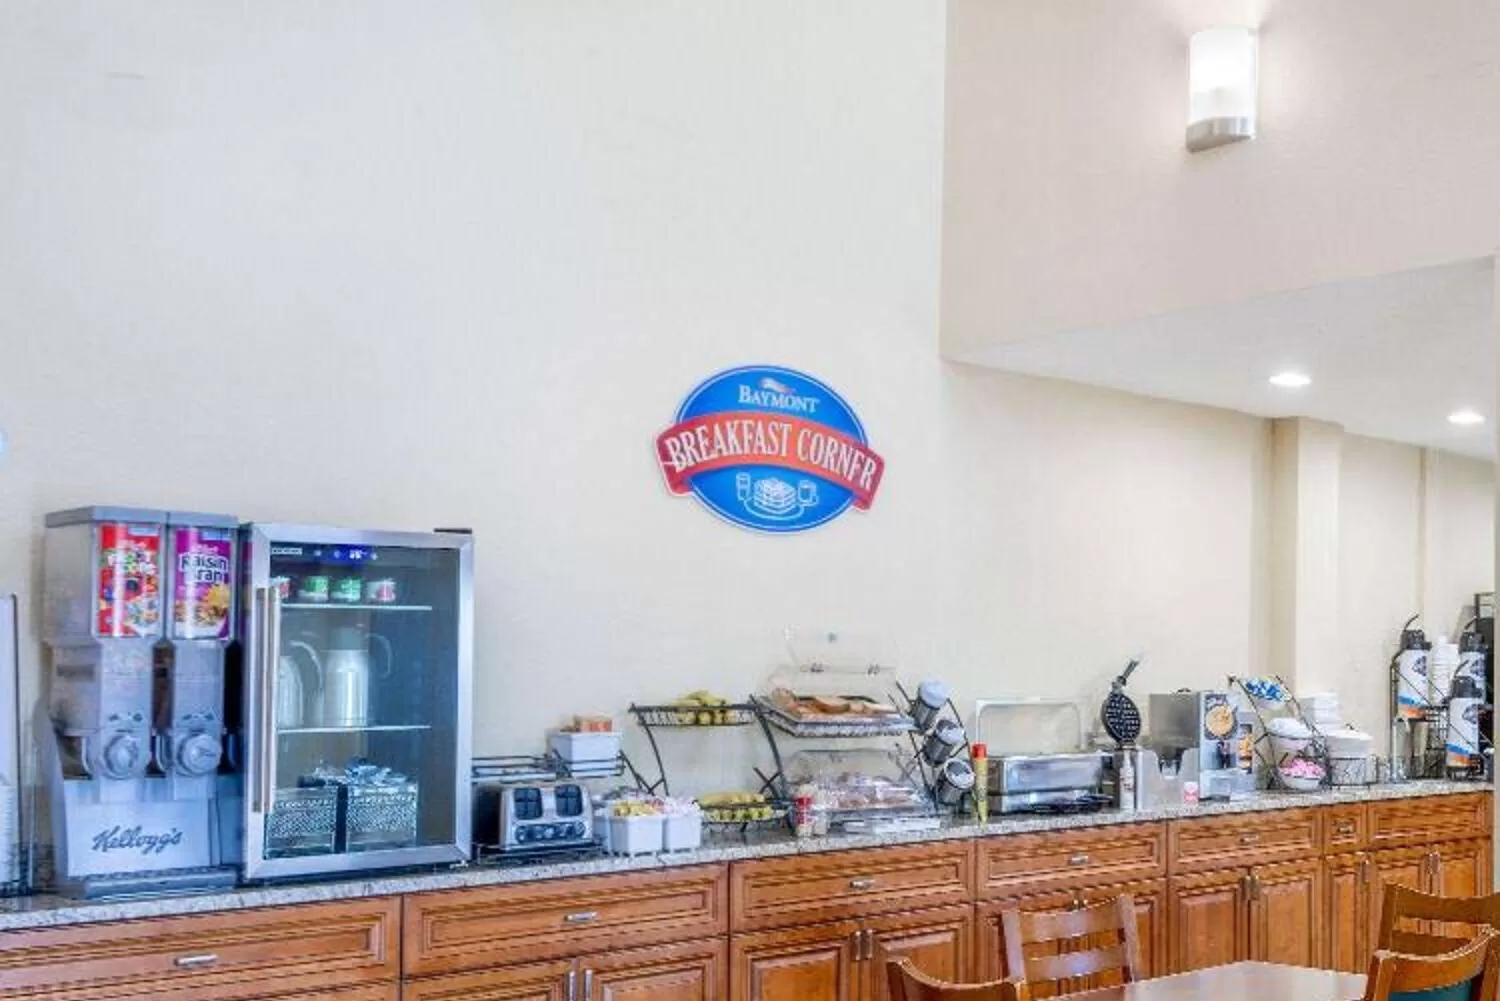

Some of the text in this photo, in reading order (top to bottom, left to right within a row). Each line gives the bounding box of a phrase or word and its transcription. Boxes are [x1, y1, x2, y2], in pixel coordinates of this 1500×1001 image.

[737, 384, 820, 413] BAYMONT
[664, 418, 877, 491] BREAKFAST CORNER
[92, 825, 183, 855] Kellogg's
